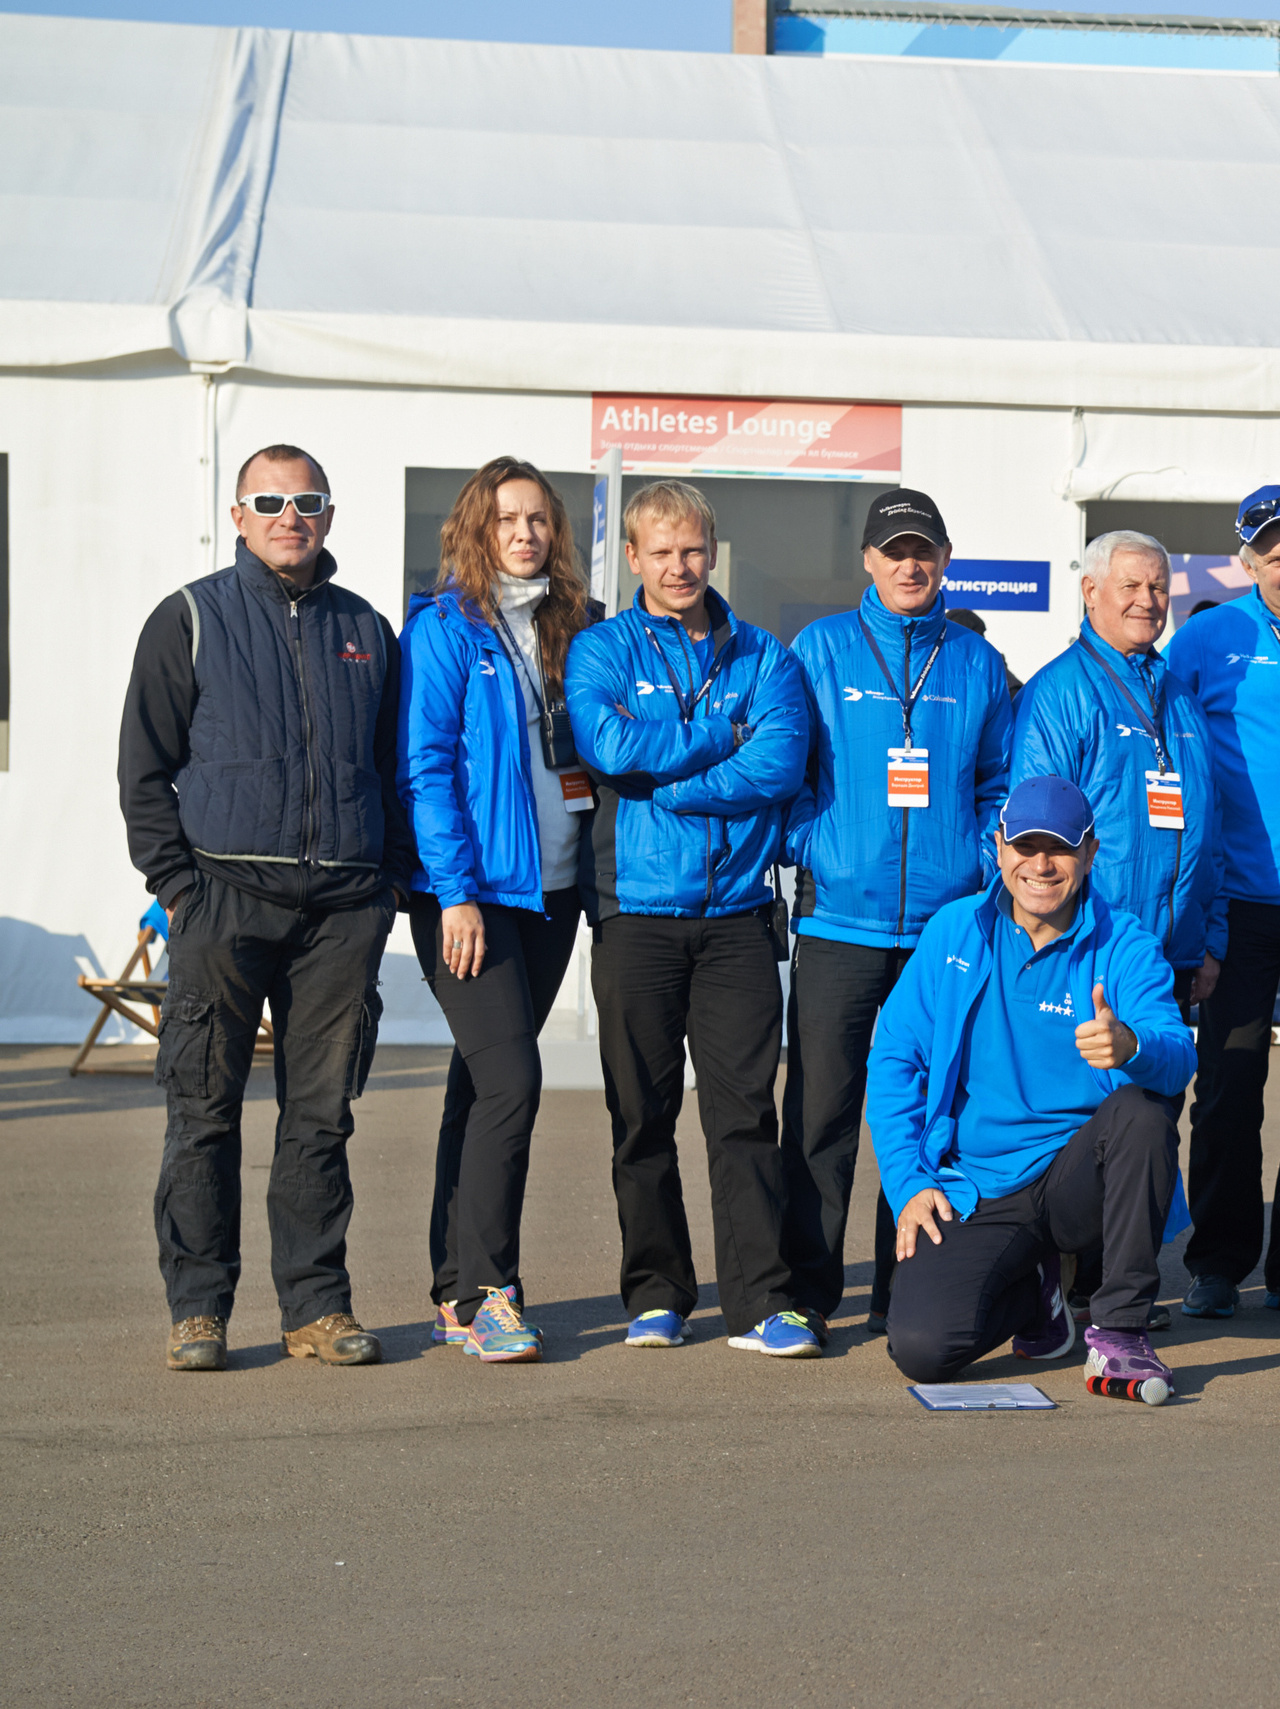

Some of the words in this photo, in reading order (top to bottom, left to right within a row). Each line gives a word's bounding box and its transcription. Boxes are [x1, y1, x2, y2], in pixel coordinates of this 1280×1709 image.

[600, 405, 718, 434] Athletes
[727, 411, 832, 443] Lounge
[624, 442, 657, 452] отдыха
[879, 502, 911, 513] Volkswagen
[939, 575, 1038, 595] Регистрация
[928, 694, 956, 703] Columbia
